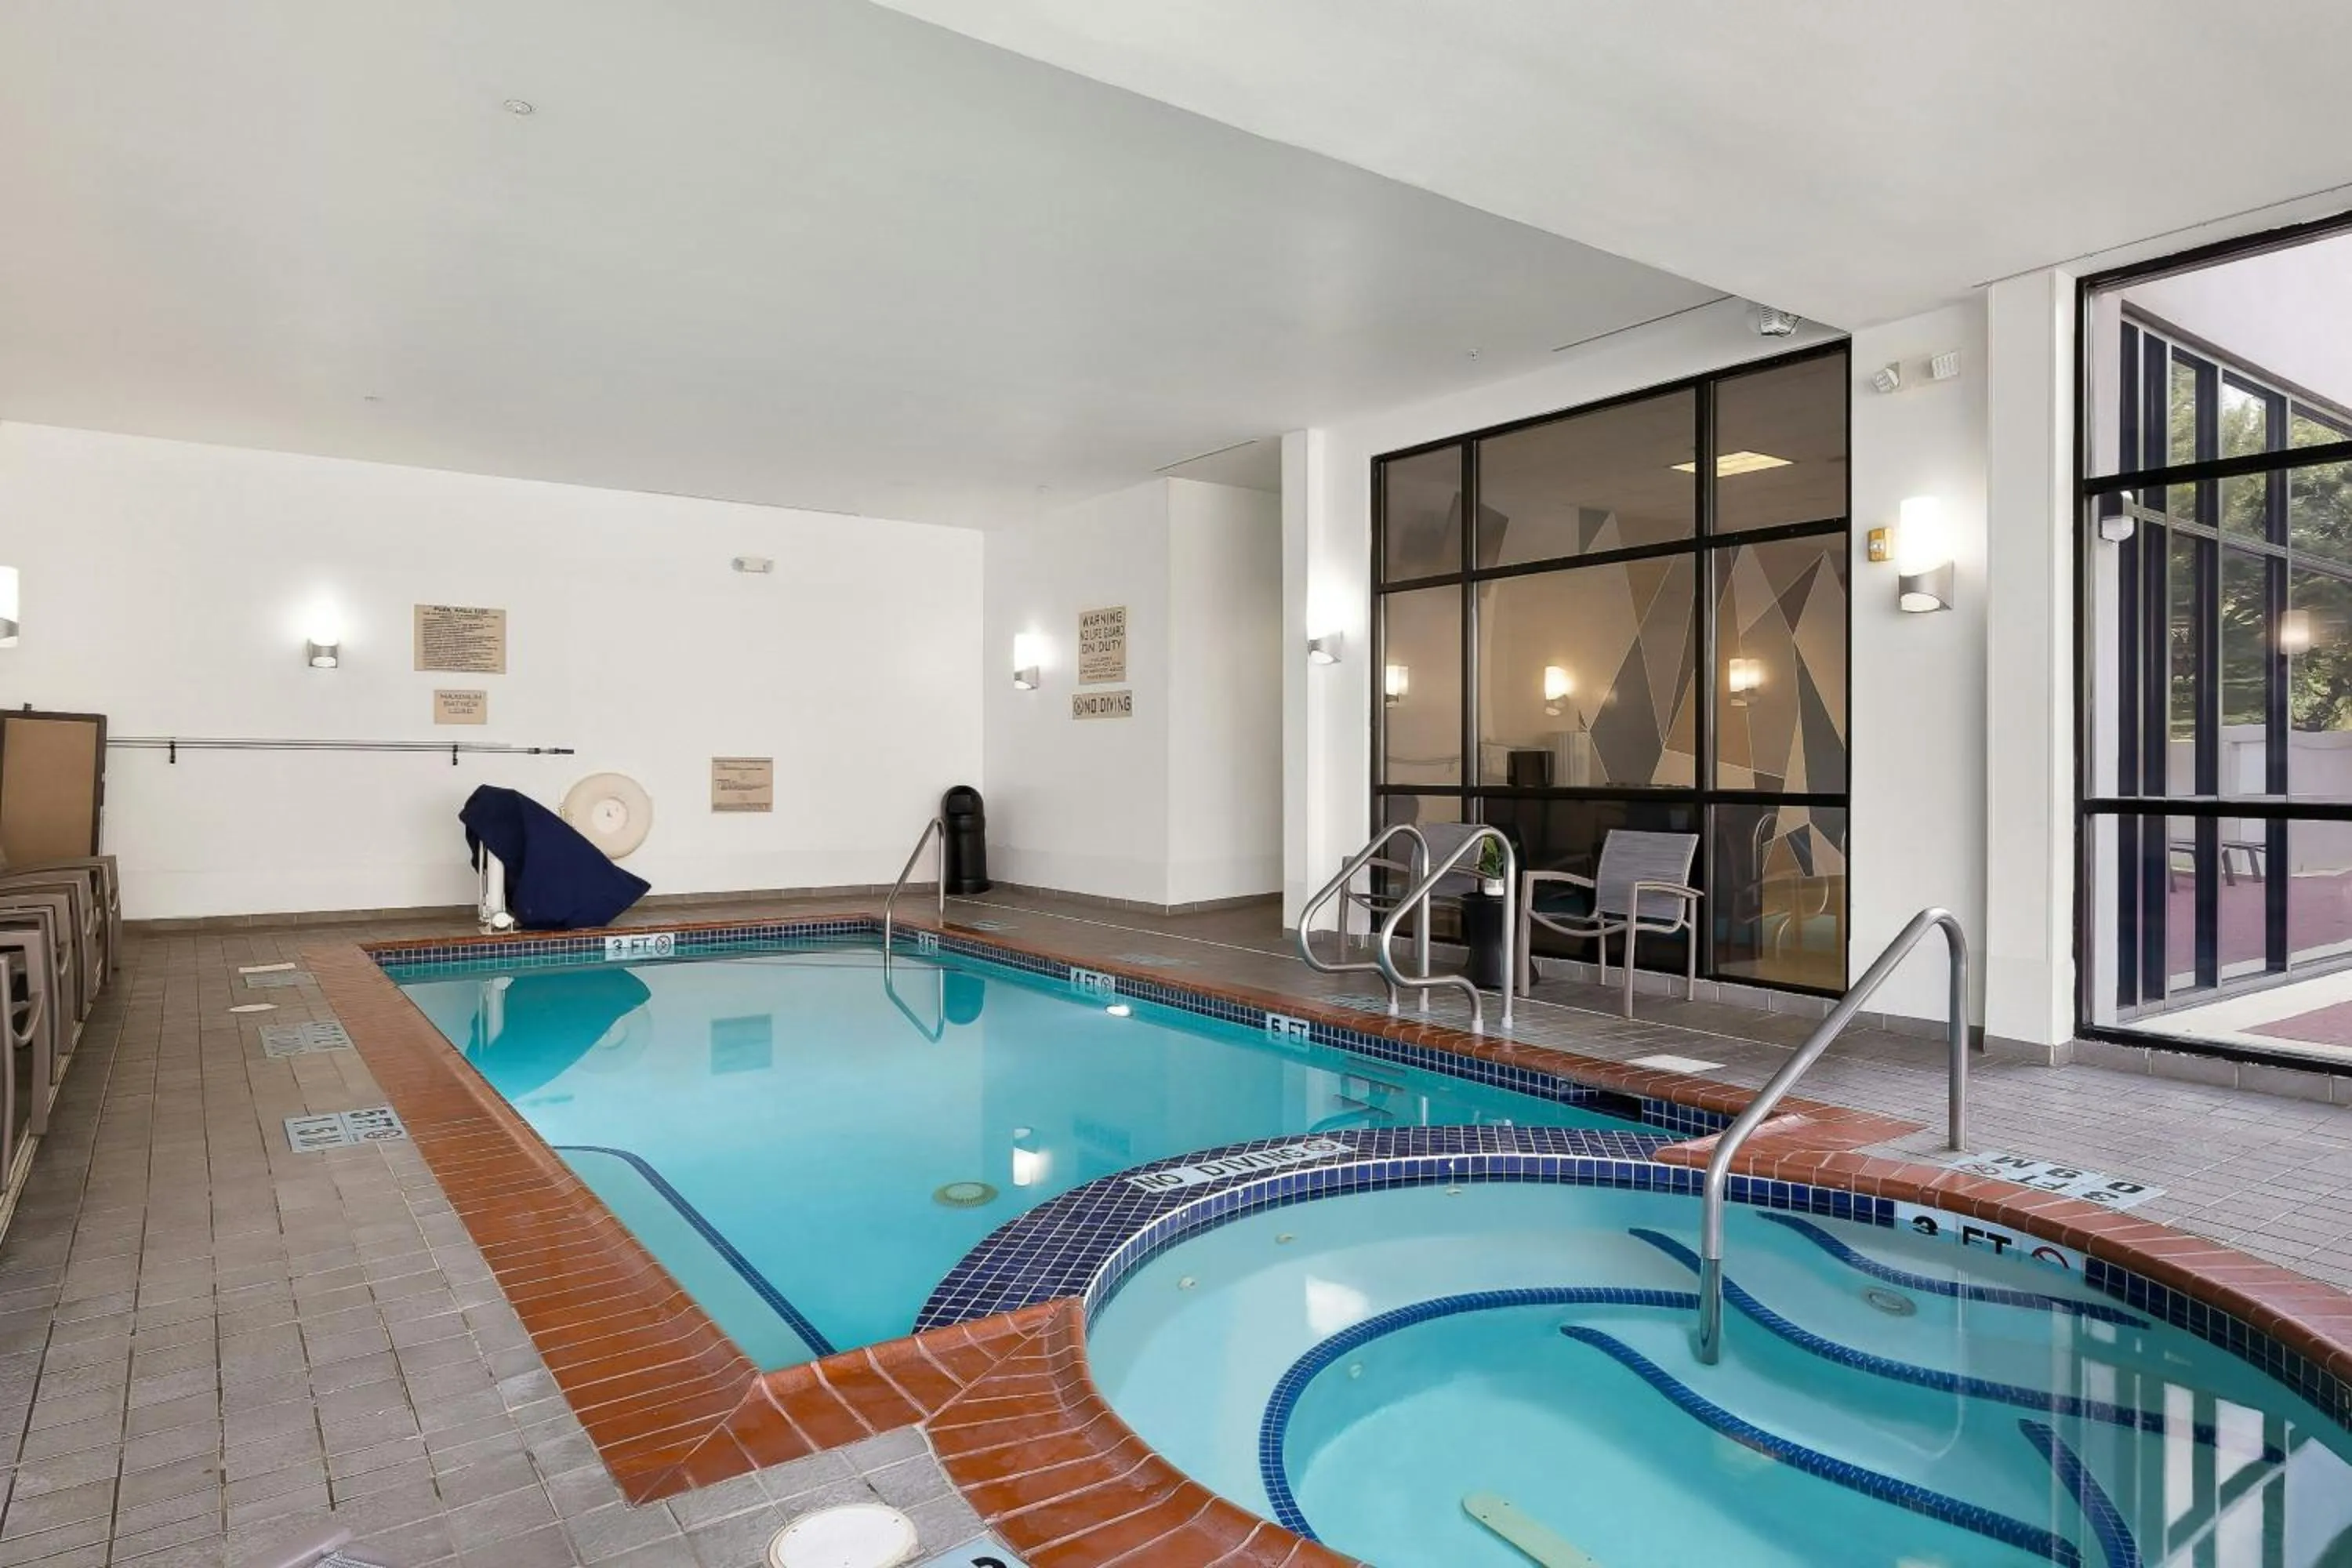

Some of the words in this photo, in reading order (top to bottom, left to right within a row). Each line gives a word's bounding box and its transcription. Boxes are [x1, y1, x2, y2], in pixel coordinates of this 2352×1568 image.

[1083, 611, 1123, 627] WARNING
[1081, 642, 1095, 655] ON
[1098, 639, 1122, 653] DUTY
[1084, 699, 1097, 714] NO
[1100, 695, 1131, 713] DIVING
[1289, 1021, 1307, 1040] FT
[1133, 1173, 1184, 1189] NO
[1195, 1148, 1305, 1177] DIVING
[2009, 1174, 2071, 1191] FT
[1962, 1225, 2013, 1254] FT
